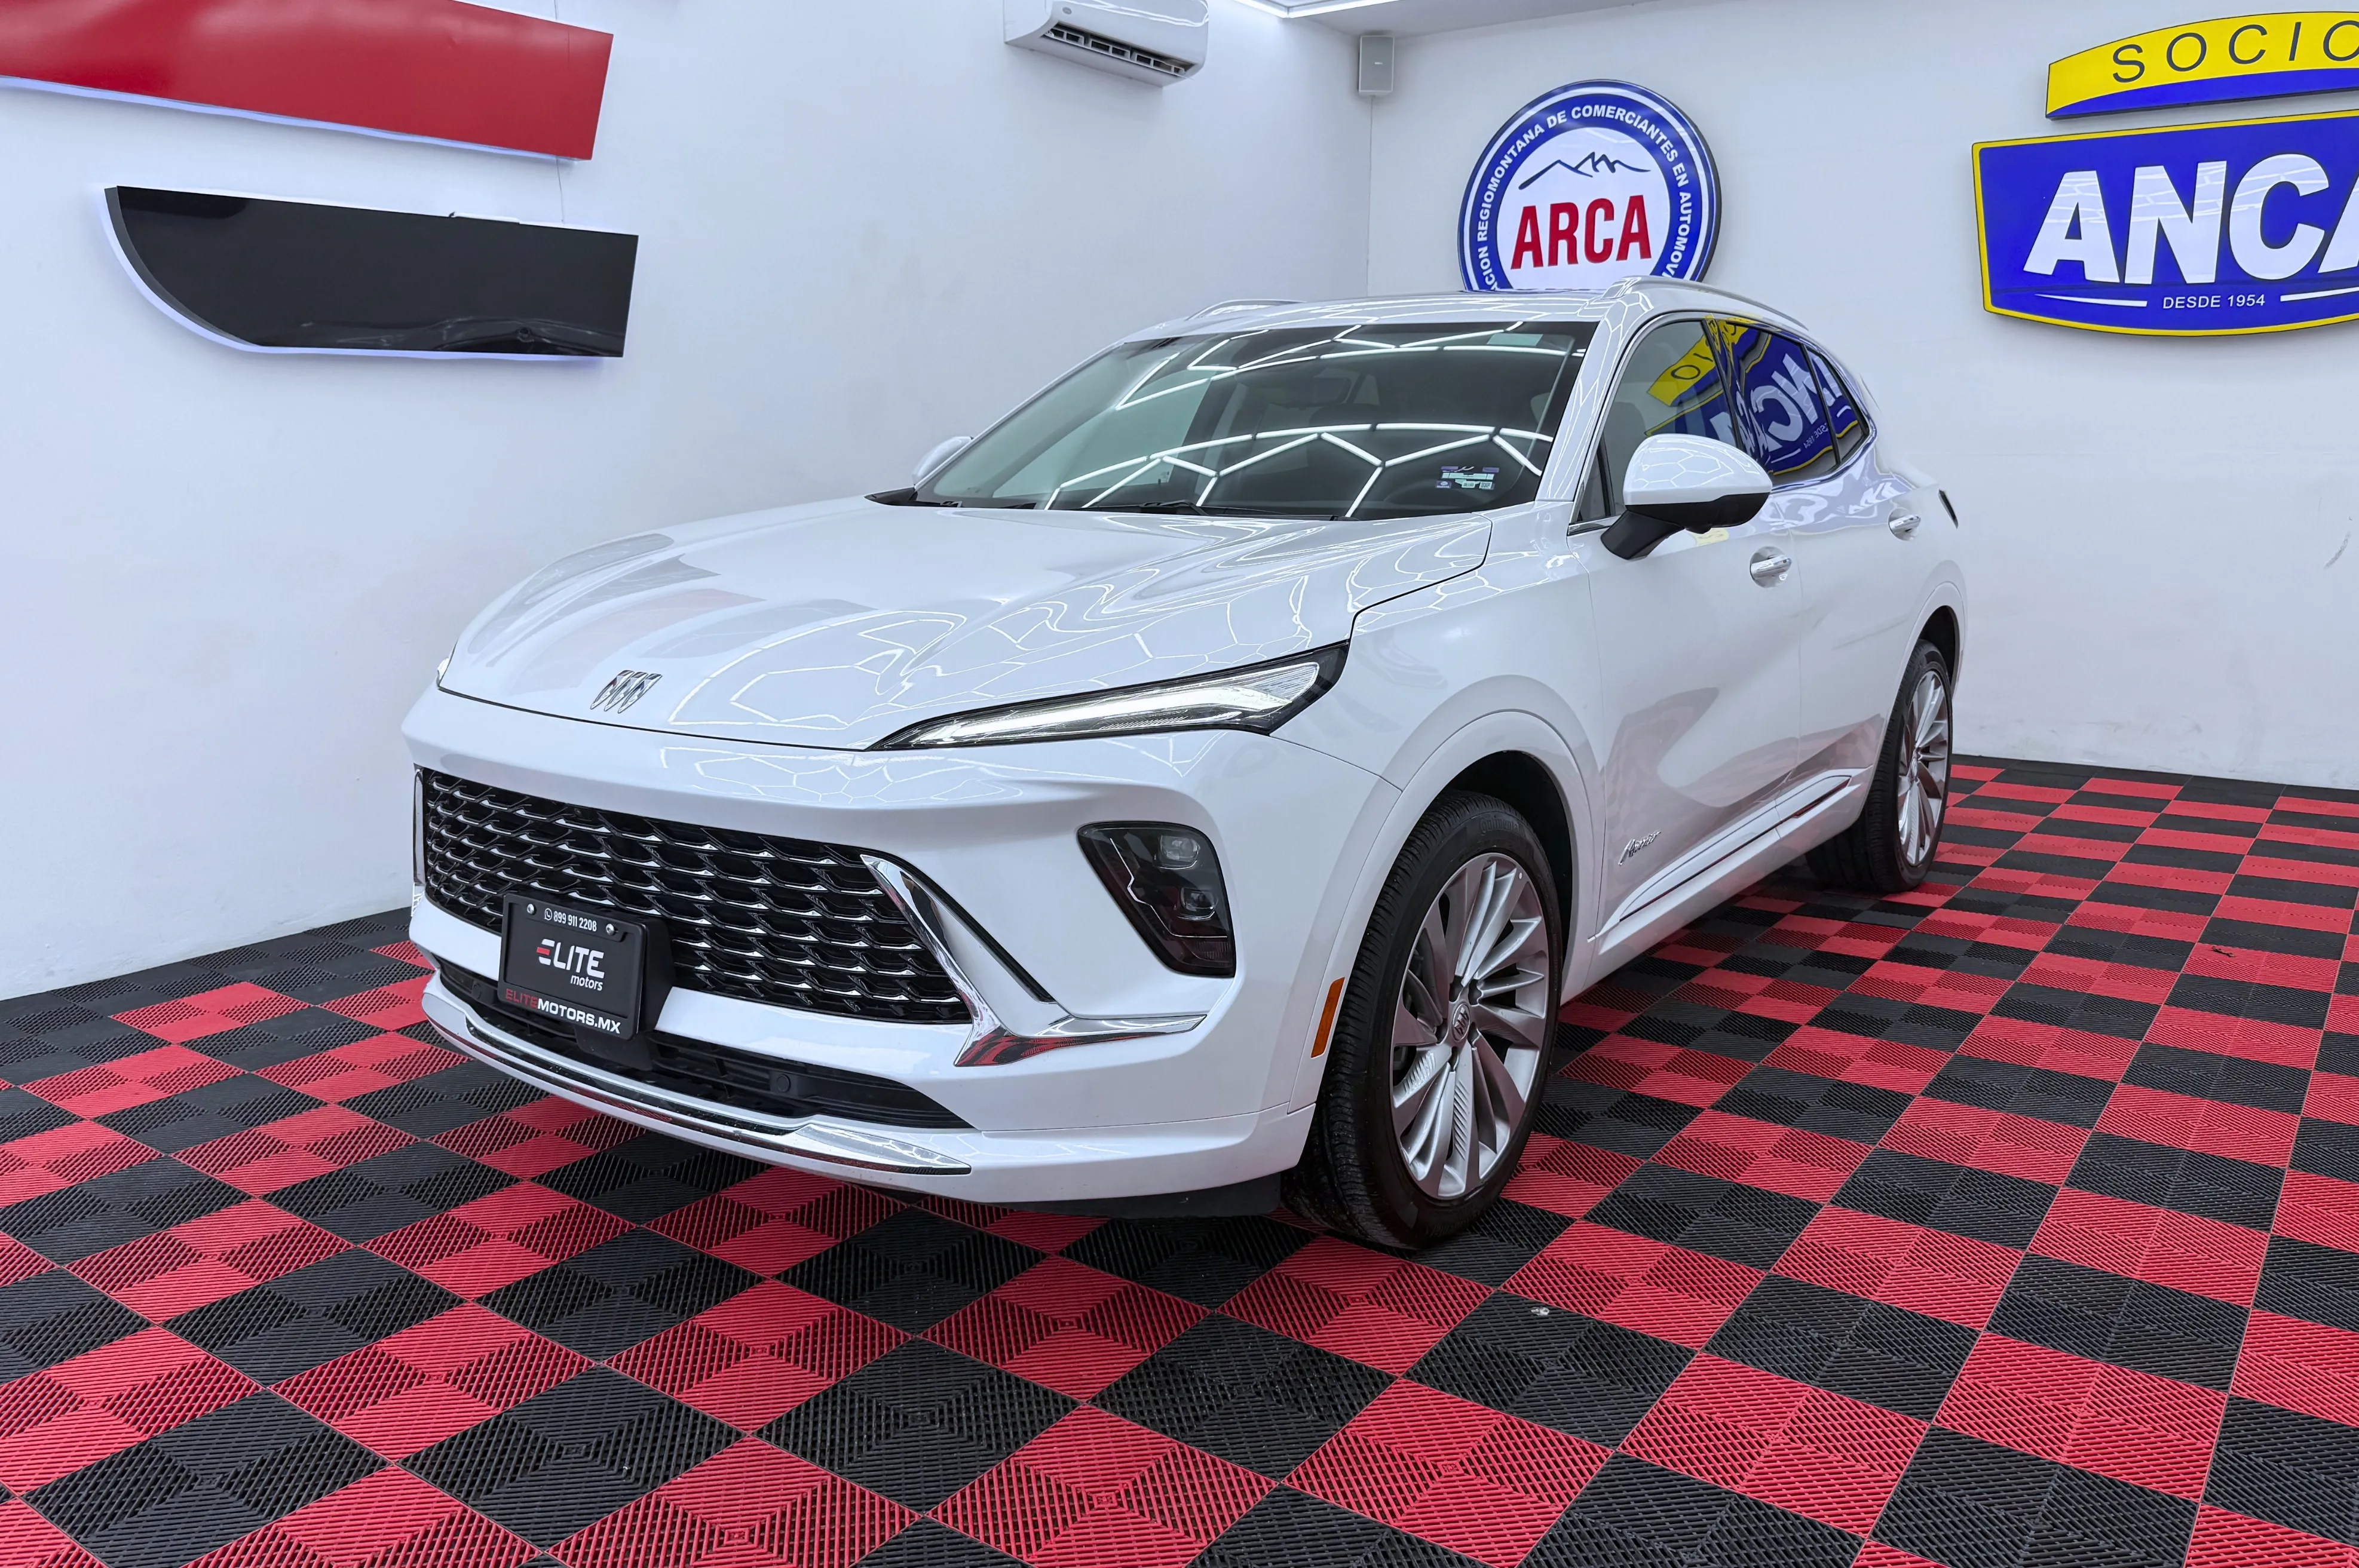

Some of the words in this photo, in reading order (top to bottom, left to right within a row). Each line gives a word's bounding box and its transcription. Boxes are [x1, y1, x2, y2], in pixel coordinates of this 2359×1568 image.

[1476, 124, 1545, 242] REGIOMONTANA
[1547, 111, 1567, 128] DE
[1571, 105, 1678, 162] COMERCIANTES
[1672, 163, 1689, 187] EN
[1511, 195, 1652, 270] ARCA
[2163, 296, 2221, 309] DESDE
[2228, 294, 2265, 307] 1954
[554, 911, 566, 924] 899
[568, 915, 578, 927] 911
[579, 918, 597, 932] 2208
[537, 938, 605, 978] ELITE
[570, 975, 603, 991] motors
[505, 988, 621, 1034] ELITEMOTORS.MX
